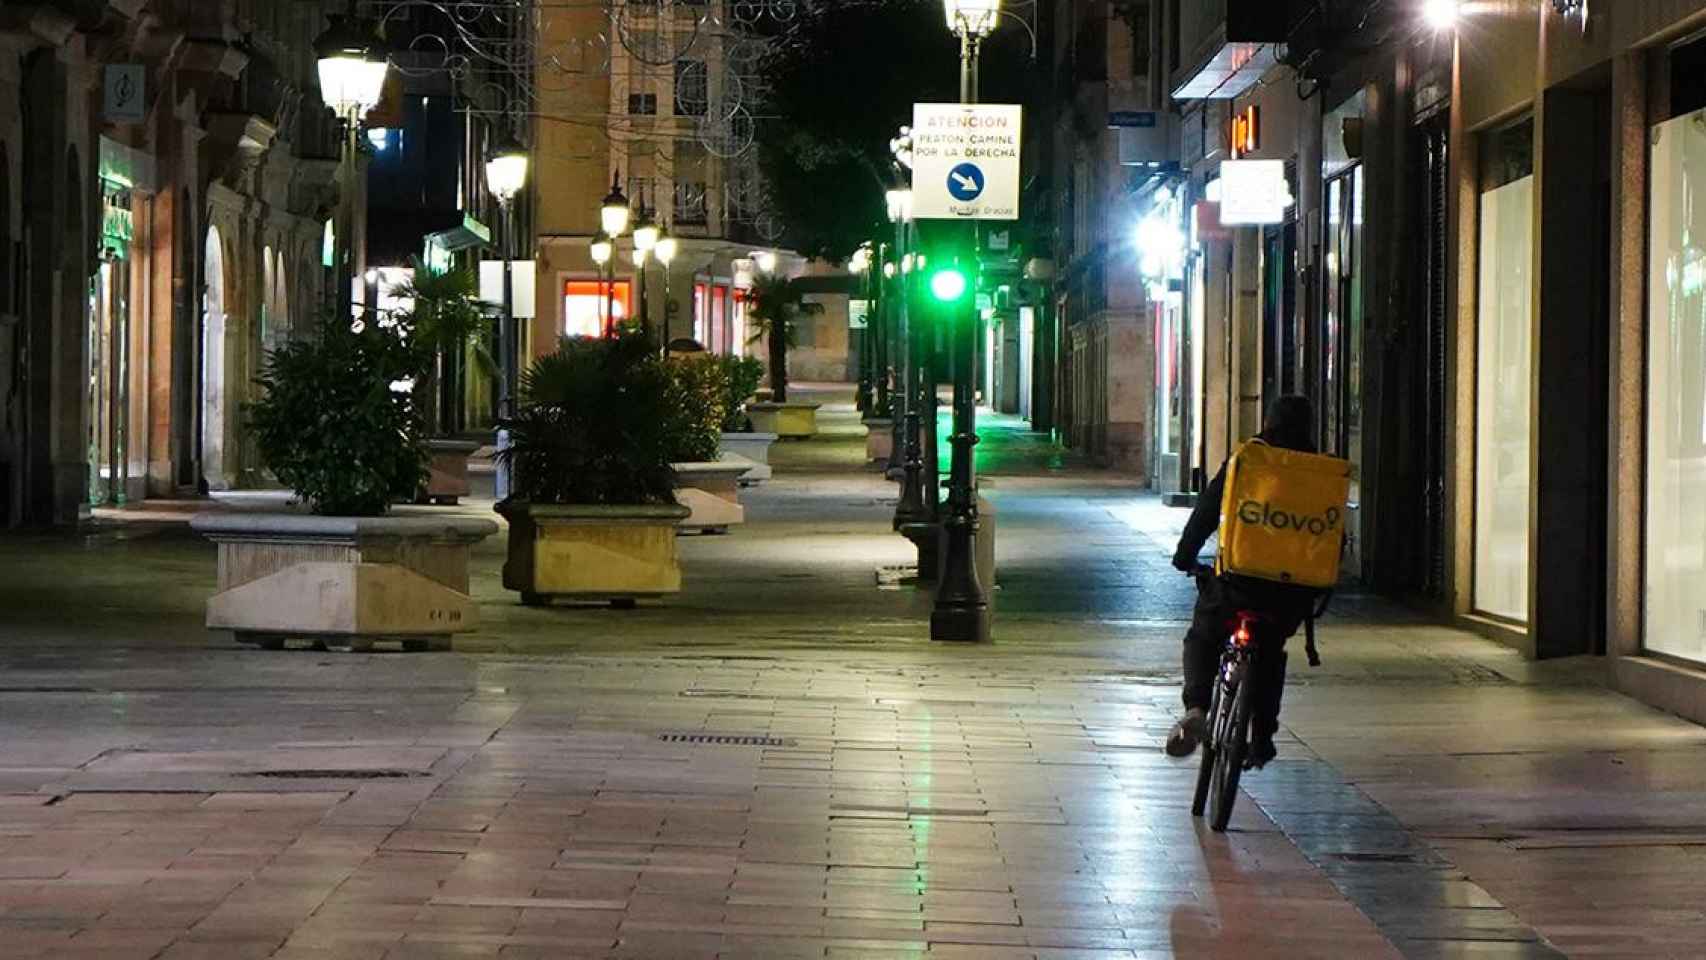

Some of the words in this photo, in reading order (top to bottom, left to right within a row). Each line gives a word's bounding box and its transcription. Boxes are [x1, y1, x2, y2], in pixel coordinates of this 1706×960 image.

[919, 134, 964, 145] PEATON
[969, 134, 1013, 145] CAMINE
[916, 147, 938, 157] POR
[944, 147, 958, 157] LA
[964, 147, 1016, 158] DERECHA
[1239, 501, 1325, 536] Glovo
